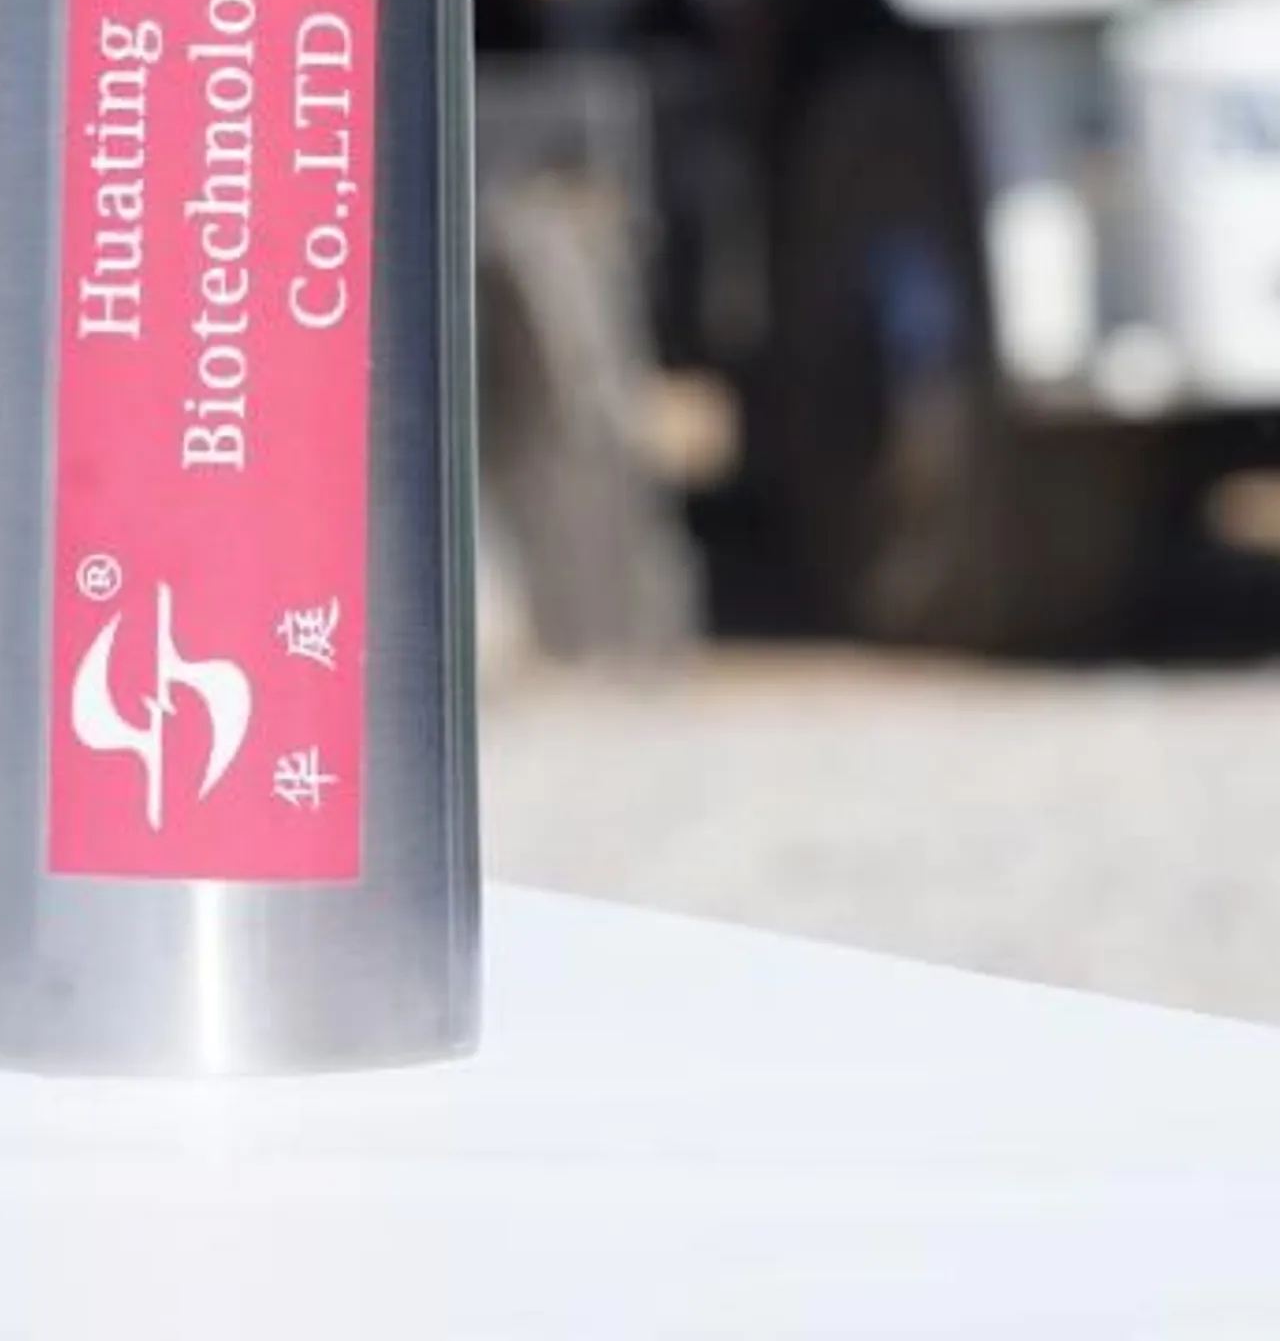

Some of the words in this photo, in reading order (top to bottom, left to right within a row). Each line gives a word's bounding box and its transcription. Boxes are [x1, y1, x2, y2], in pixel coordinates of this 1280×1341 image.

[78, 17, 163, 340] Huating
[288, 11, 356, 330] Co.,LTD
[271, 595, 341, 811] 华庭
